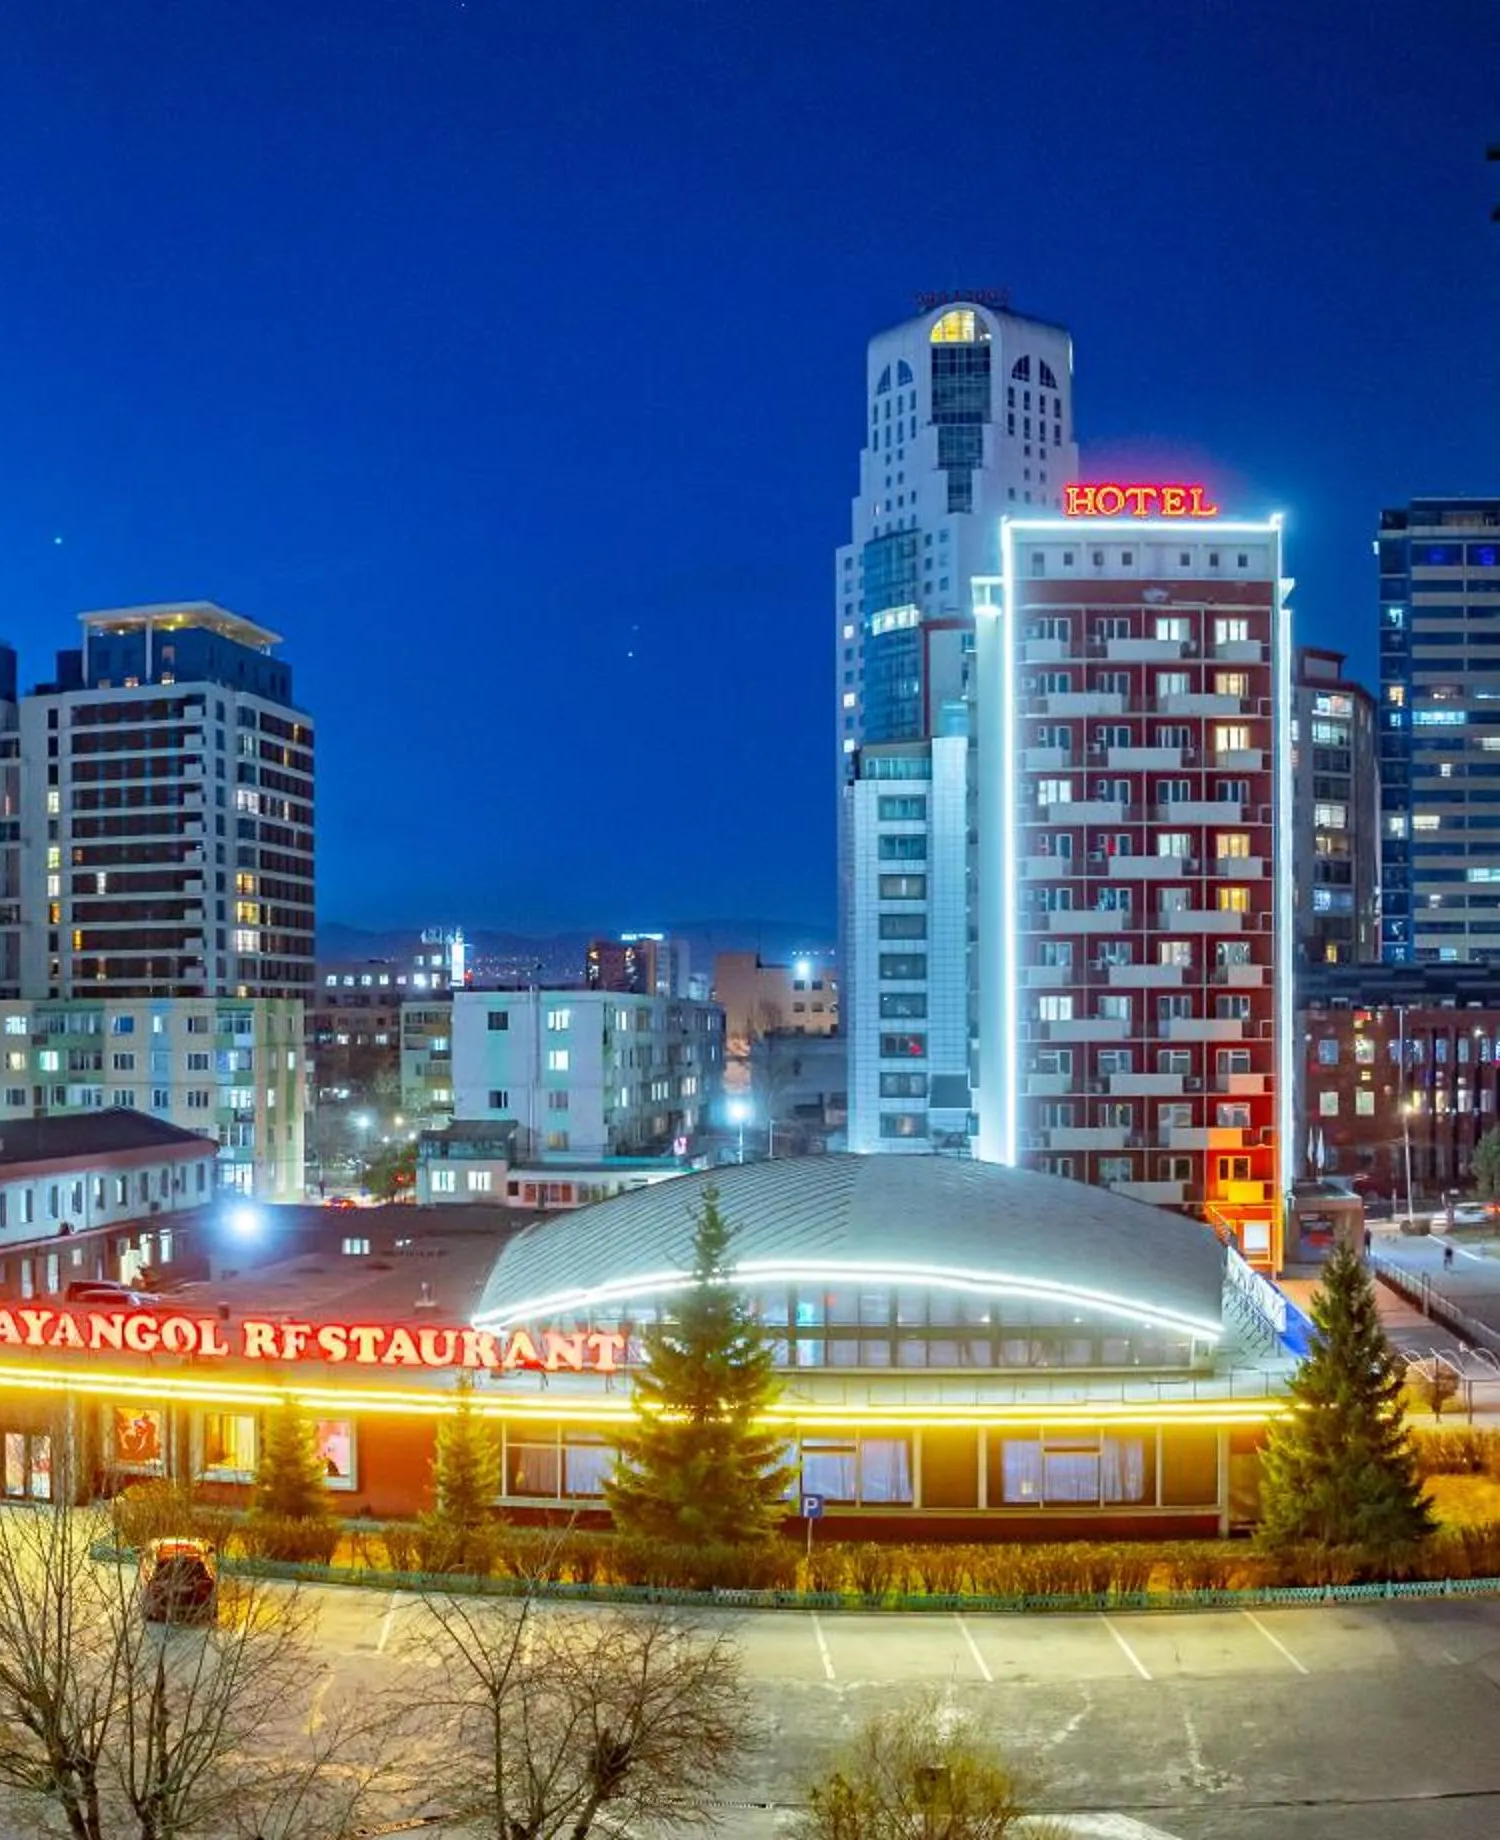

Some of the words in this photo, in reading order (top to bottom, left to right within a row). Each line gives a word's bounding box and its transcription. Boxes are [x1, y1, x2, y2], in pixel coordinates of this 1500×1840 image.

[1065, 485, 1218, 516] HOTEL
[243, 1320, 625, 1371] RESTAURANT
[803, 1497, 819, 1518] P
